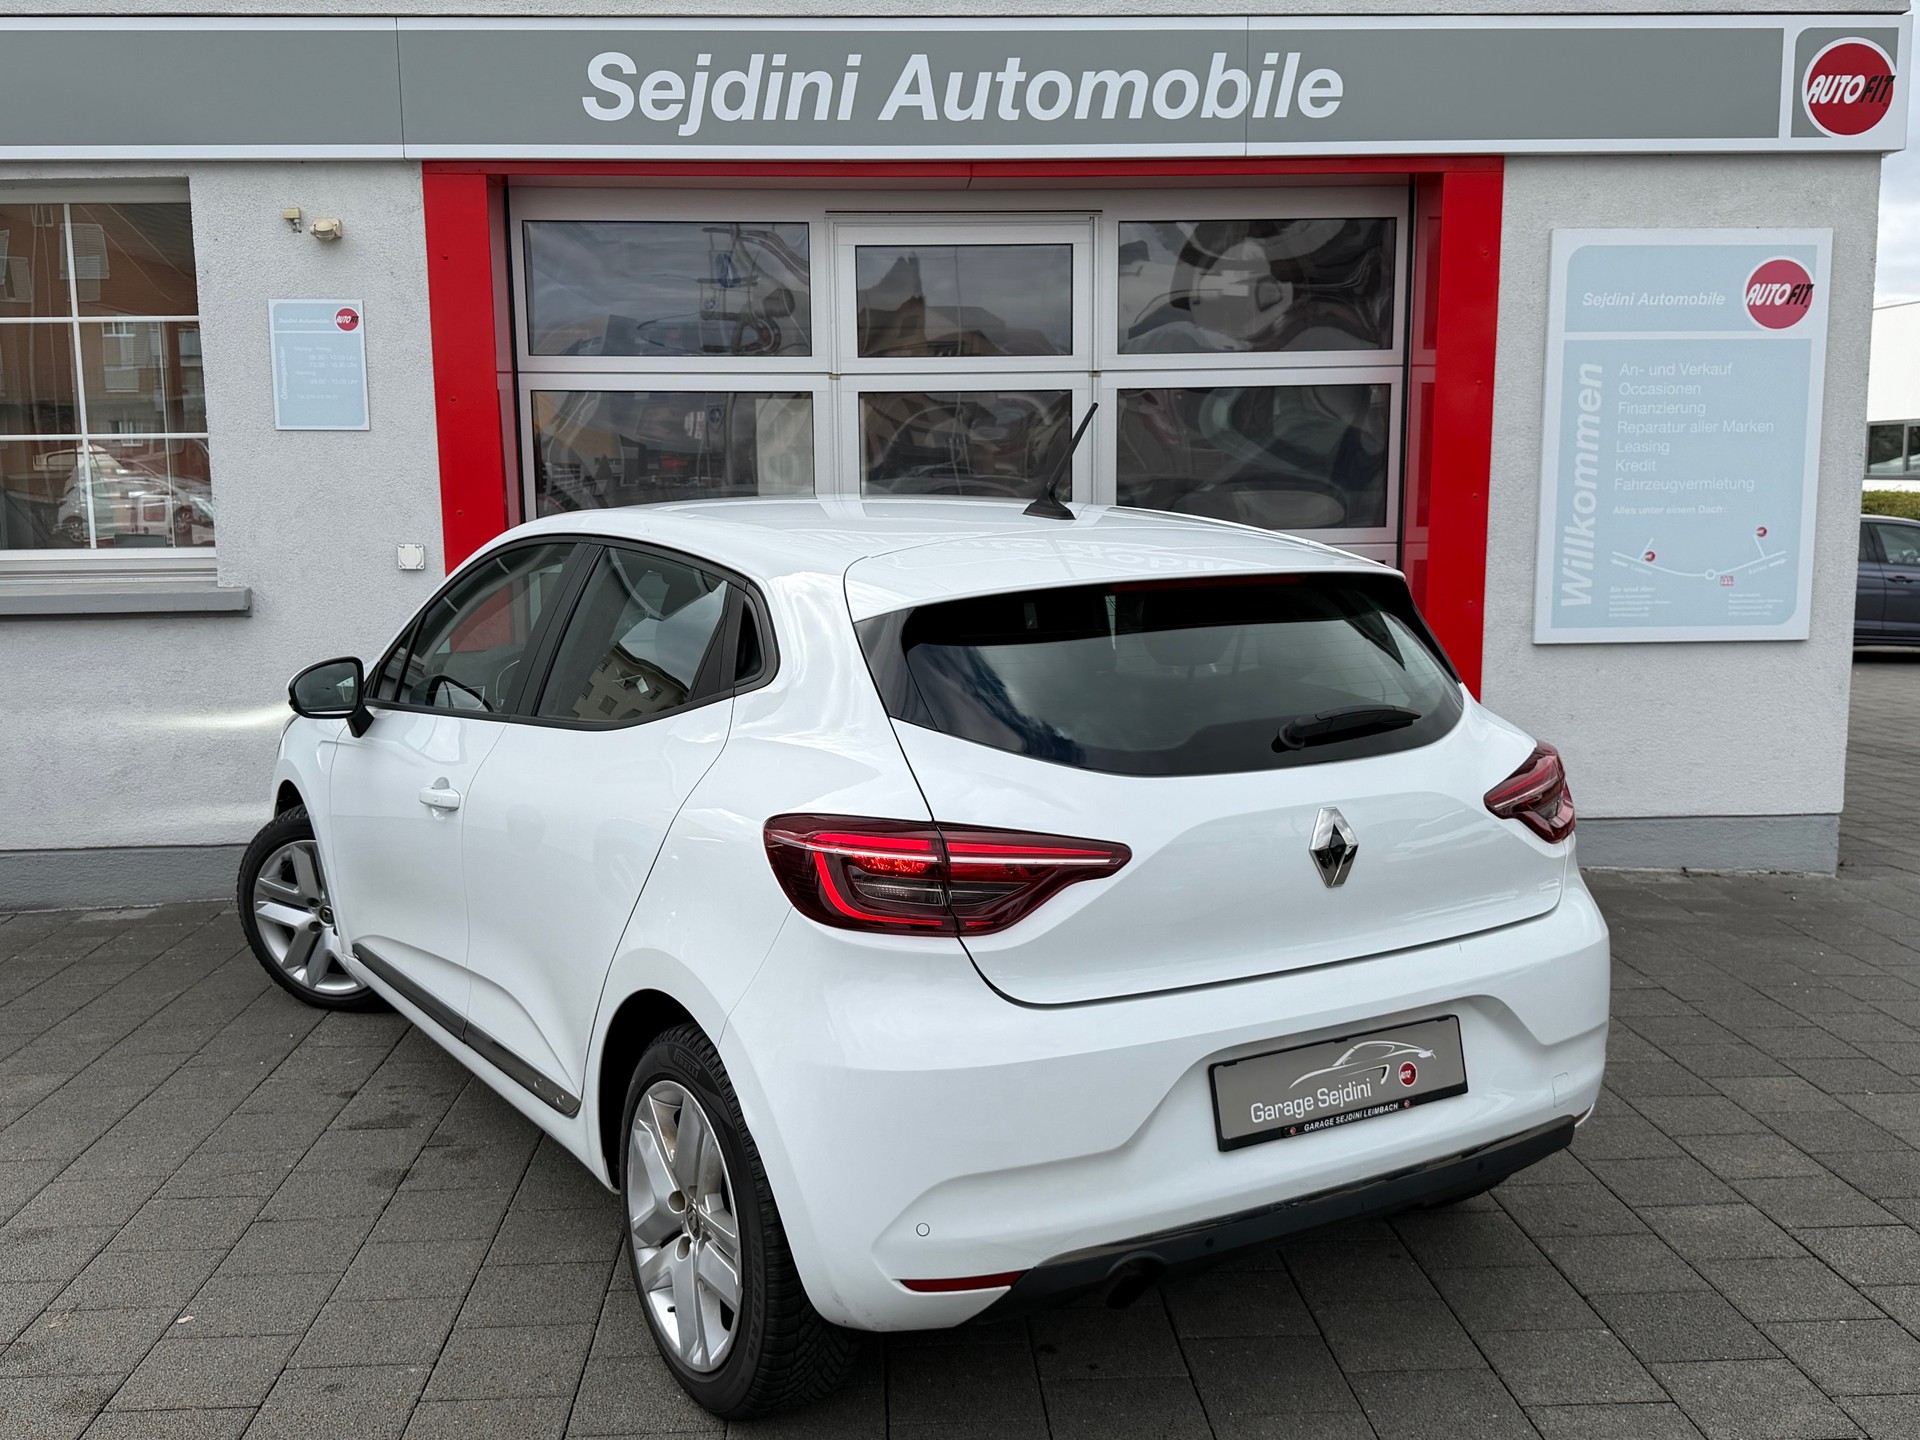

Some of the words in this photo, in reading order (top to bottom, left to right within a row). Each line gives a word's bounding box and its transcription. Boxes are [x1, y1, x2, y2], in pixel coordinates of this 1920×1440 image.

[582, 52, 861, 135] Sejdini
[879, 53, 1344, 121] Automobile
[1582, 292, 1635, 308] Sejdini
[1638, 292, 1726, 306] Automobile
[1619, 363, 1644, 376] An-
[1649, 363, 1675, 376] und
[1679, 362, 1733, 376] Verkauf
[1618, 382, 1701, 396] Occasionen
[1617, 401, 1706, 417] Finanzierung
[1617, 421, 1686, 436] Reparatur
[1689, 420, 1720, 433] aller
[1723, 419, 1774, 433] Marken
[1616, 440, 1670, 455] Leasing
[1615, 459, 1657, 472] Kredit
[1561, 363, 1603, 607] Willkommen
[1614, 477, 1755, 492] Fahrzeugvermietung
[1612, 506, 1636, 515] Alles
[1638, 506, 1664, 515] unter
[1666, 505, 1696, 514] einem
[1250, 1096, 1314, 1123] Garage
[1317, 1078, 1372, 1108] Sejdini
[1304, 1117, 1334, 1132] GARAGE
[1335, 1110, 1363, 1125] SEJDINI
[1363, 1102, 1399, 1118] LEIMBACH
